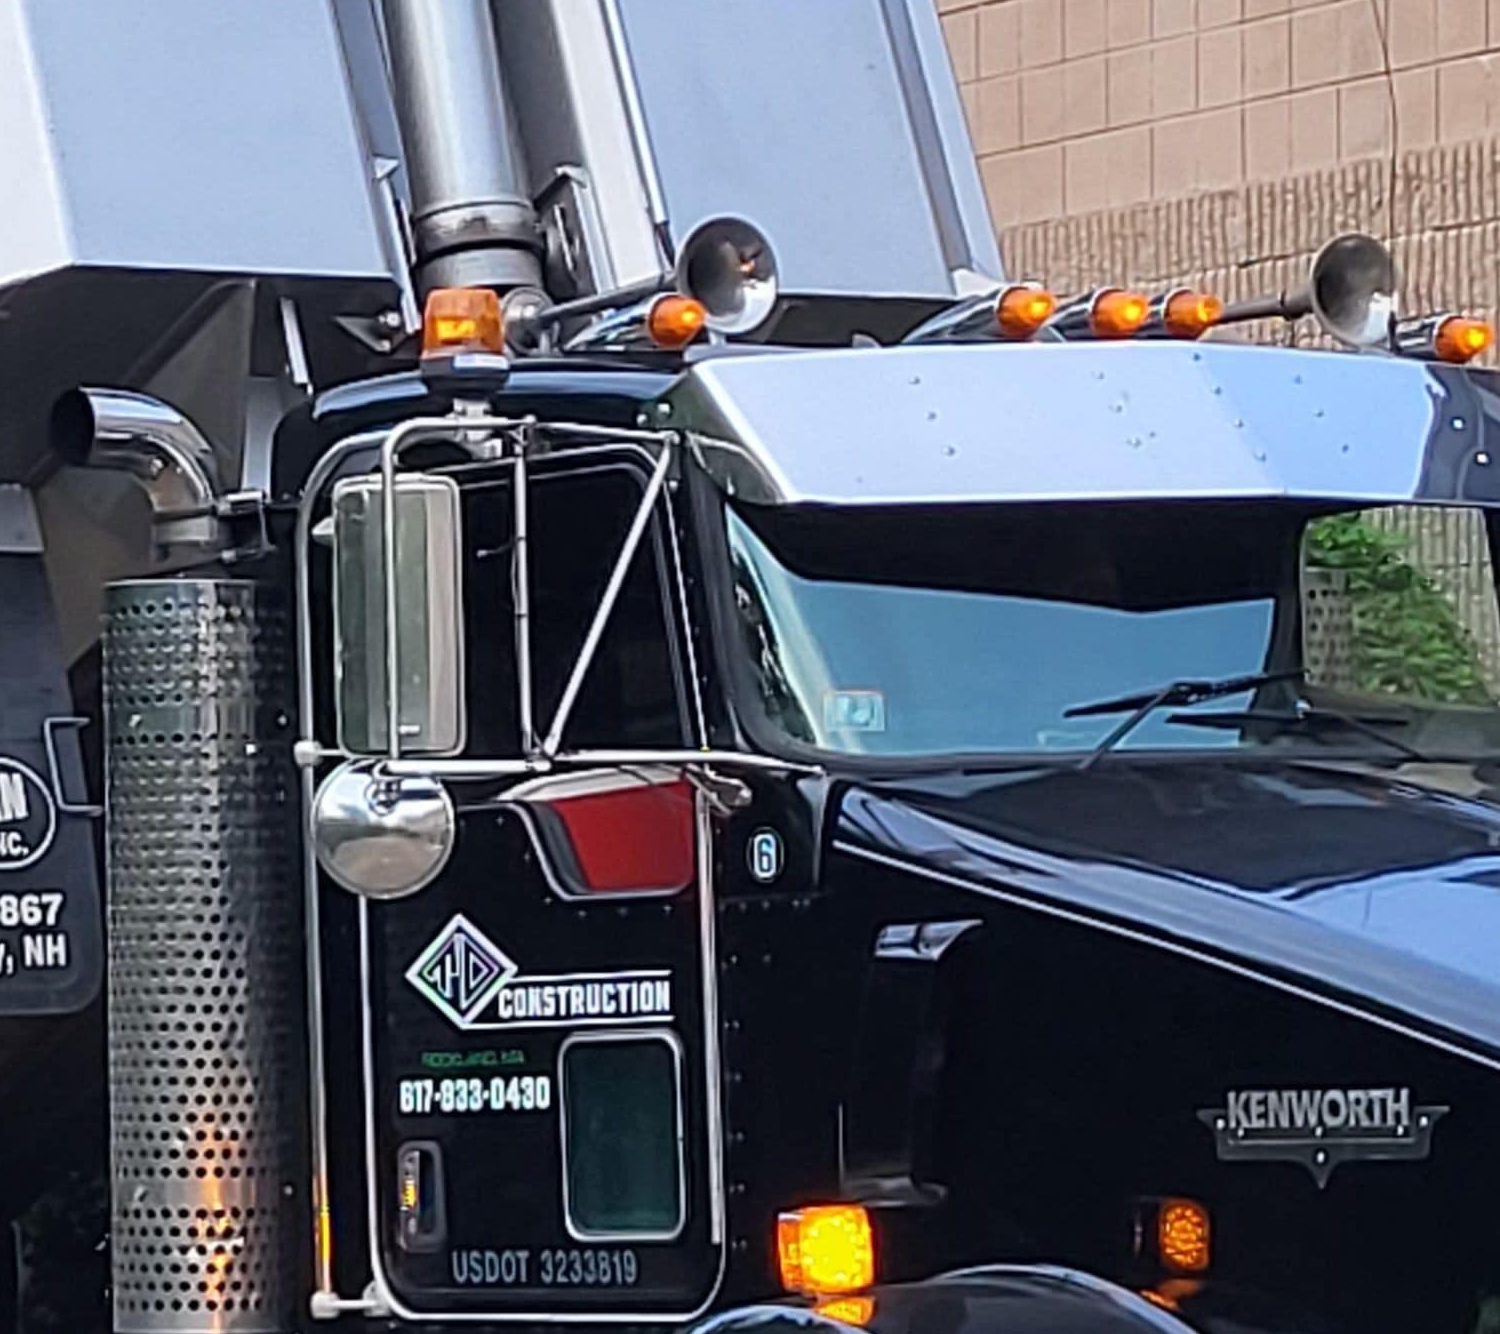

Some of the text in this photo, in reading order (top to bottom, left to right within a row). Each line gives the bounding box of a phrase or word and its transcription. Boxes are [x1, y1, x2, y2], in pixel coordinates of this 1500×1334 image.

[753, 833, 777, 878] 6
[23, 933, 67, 967] NH
[498, 980, 670, 1019] CONSTRUCTION
[1227, 1087, 1410, 1129] KENWORTH
[452, 1249, 638, 1284] USDOT 3233819
